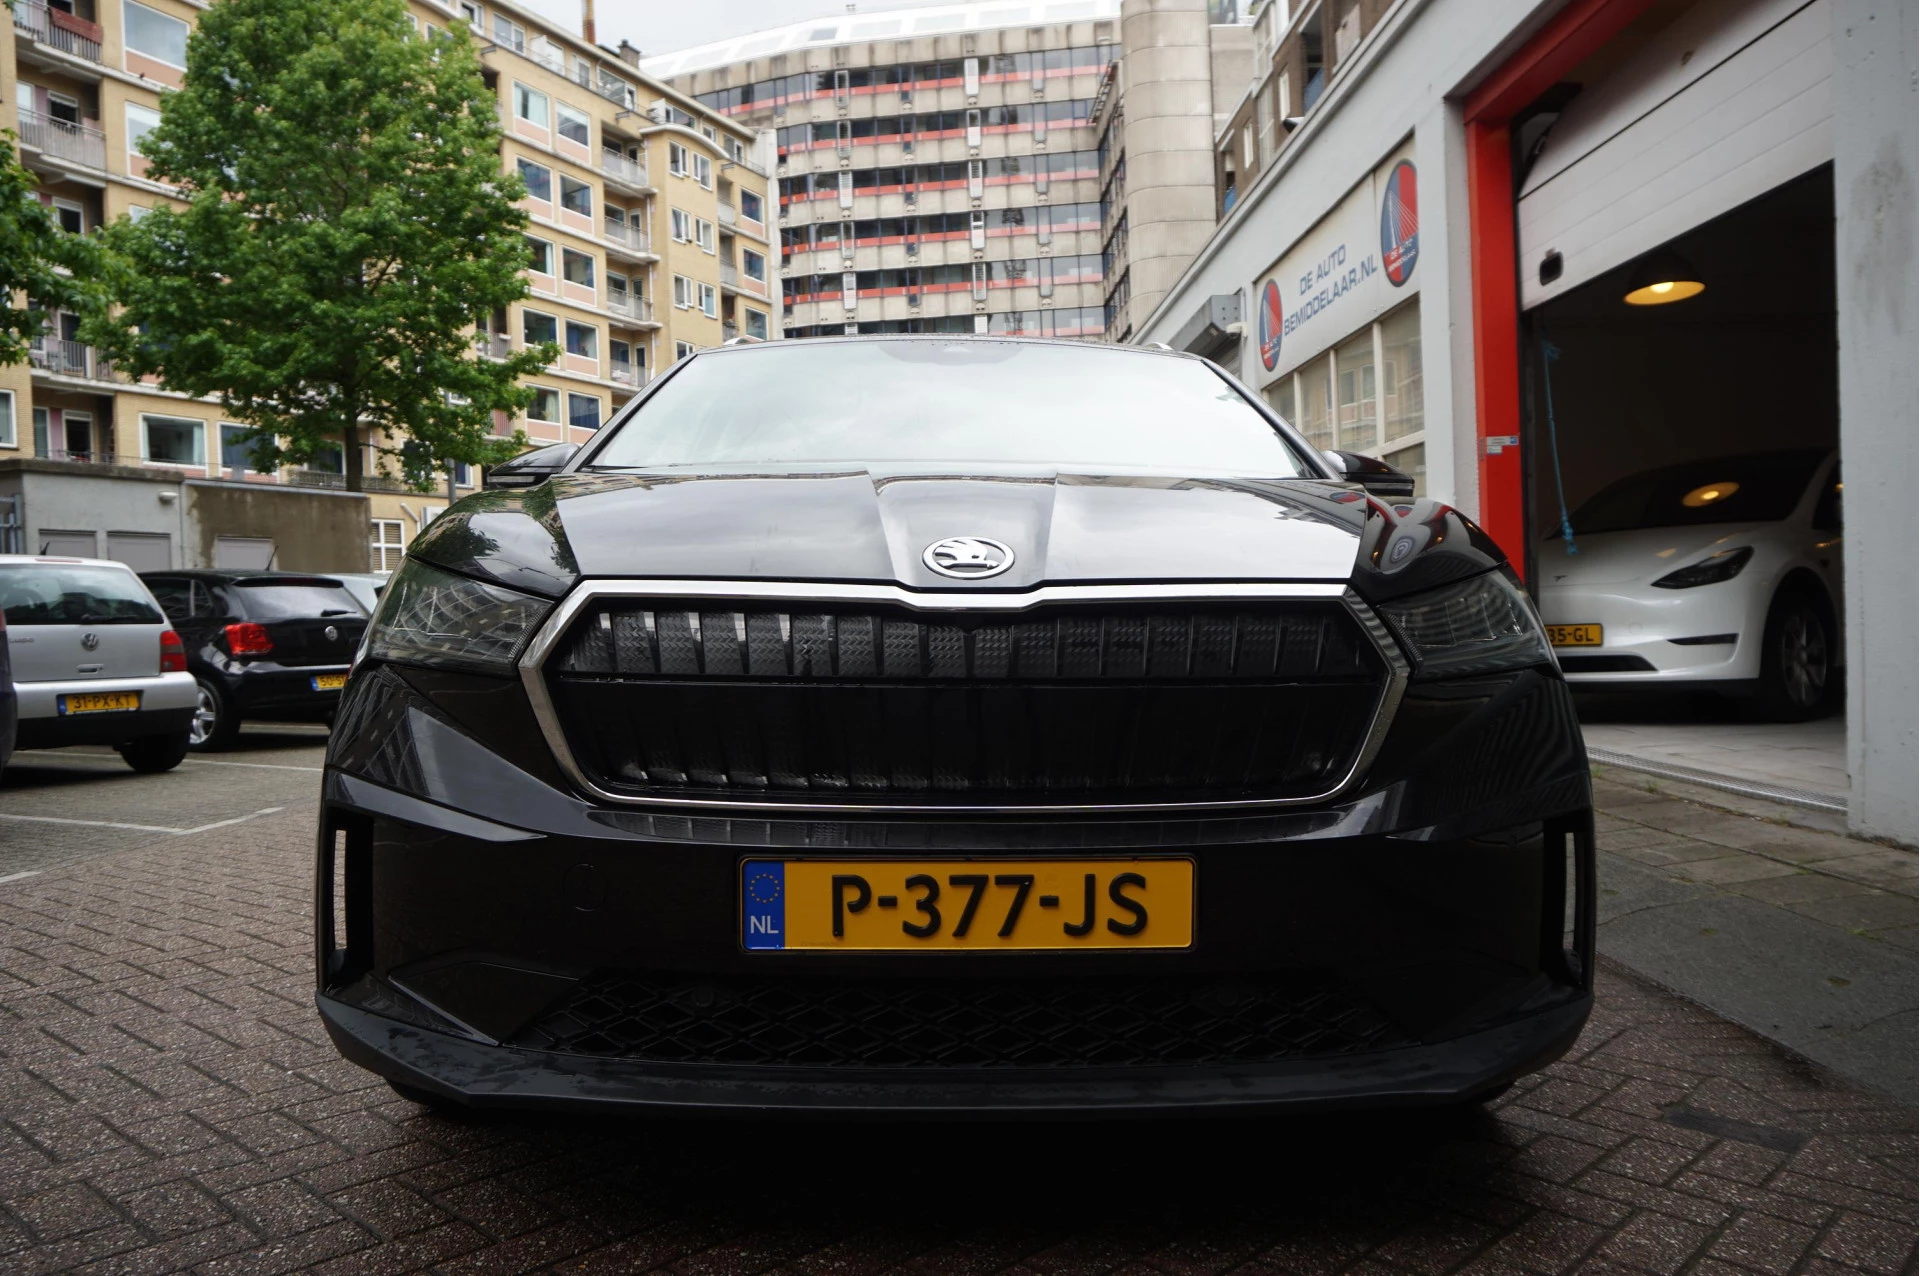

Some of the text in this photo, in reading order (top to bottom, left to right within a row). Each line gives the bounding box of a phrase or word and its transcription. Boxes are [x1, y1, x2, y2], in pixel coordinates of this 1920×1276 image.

[1284, 253, 1377, 336] BEMIDDELAAR.NL
[1300, 244, 1346, 296] DE AUTO
[73, 693, 131, 709] 31-PX-KT
[750, 916, 779, 934] NL
[831, 873, 1149, 938] P-377-JS
